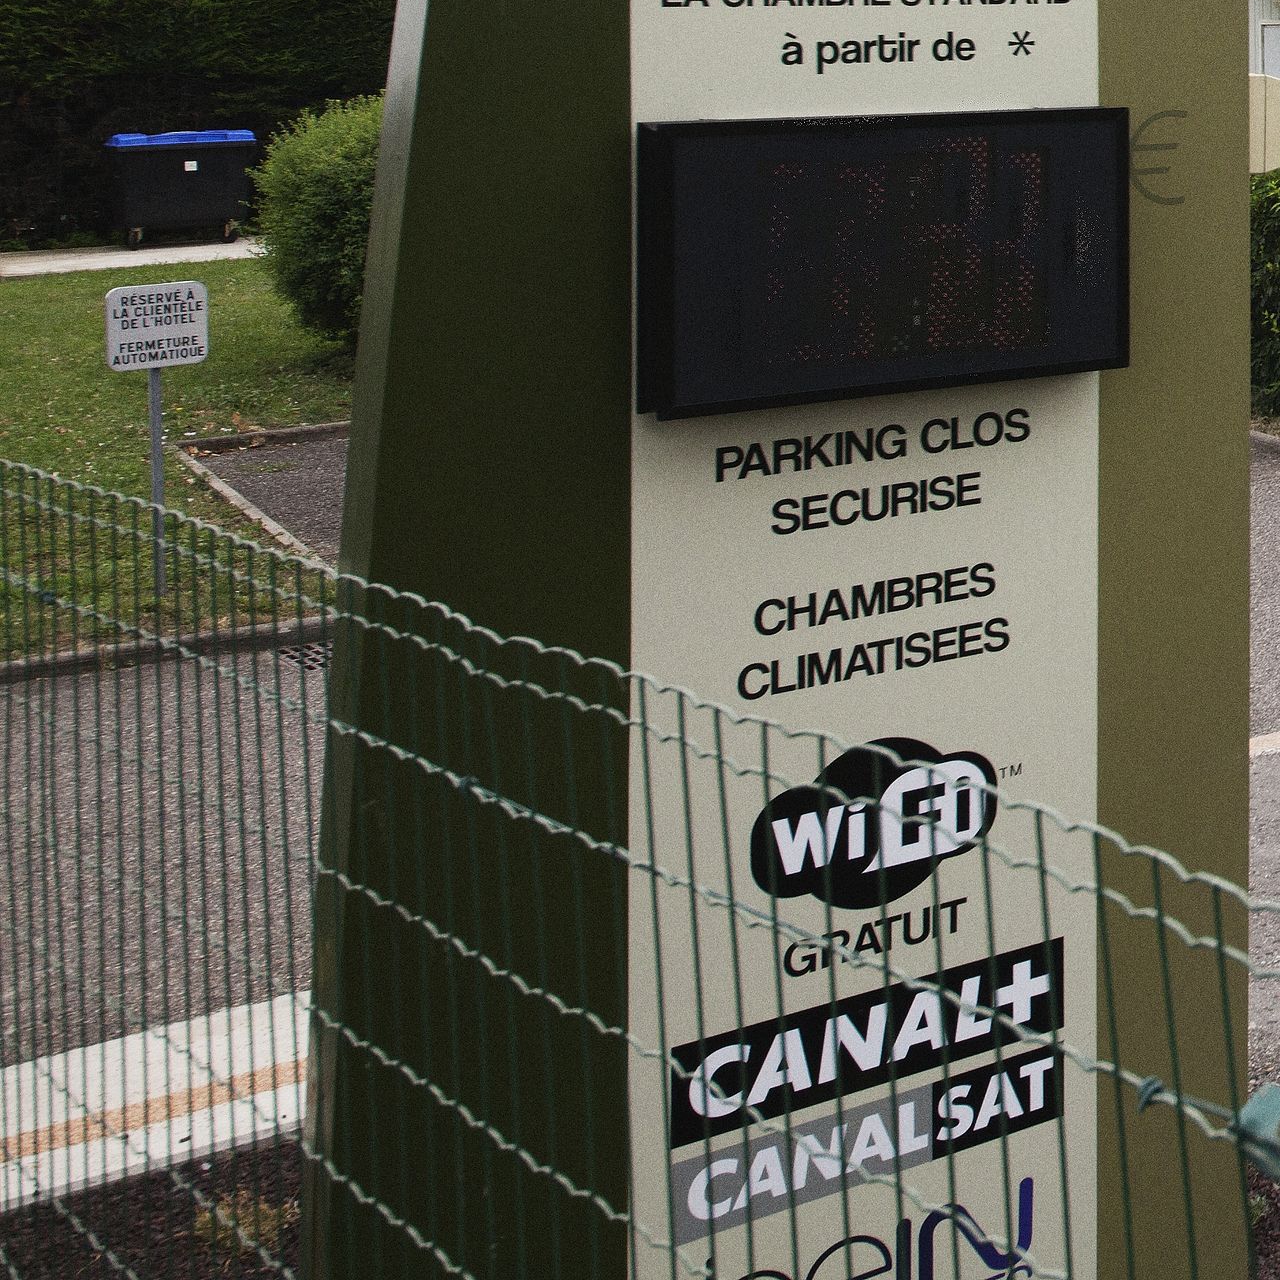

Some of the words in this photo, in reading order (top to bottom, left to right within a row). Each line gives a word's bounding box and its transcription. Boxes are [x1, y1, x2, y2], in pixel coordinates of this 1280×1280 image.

[781, 30, 804, 66] à
[816, 29, 921, 75] partir
[931, 30, 976, 62] de
[112, 309, 129, 319] LA
[134, 300, 204, 318] CLIENTÈLE
[121, 289, 182, 306] RÉSERVÉ
[121, 319, 139, 330] DE
[112, 346, 205, 365] AUTOMATIQUE
[119, 335, 199, 353] FERMETURE
[714, 423, 907, 483] PARKING
[920, 407, 1031, 454] CLOS
[770, 471, 982, 536] SECURISE
[753, 561, 997, 638] CHAMBRES
[736, 616, 1011, 701] CLIMATISEES
[782, 896, 968, 978] GRATUIT
[688, 959, 1051, 1121] CANAL+
